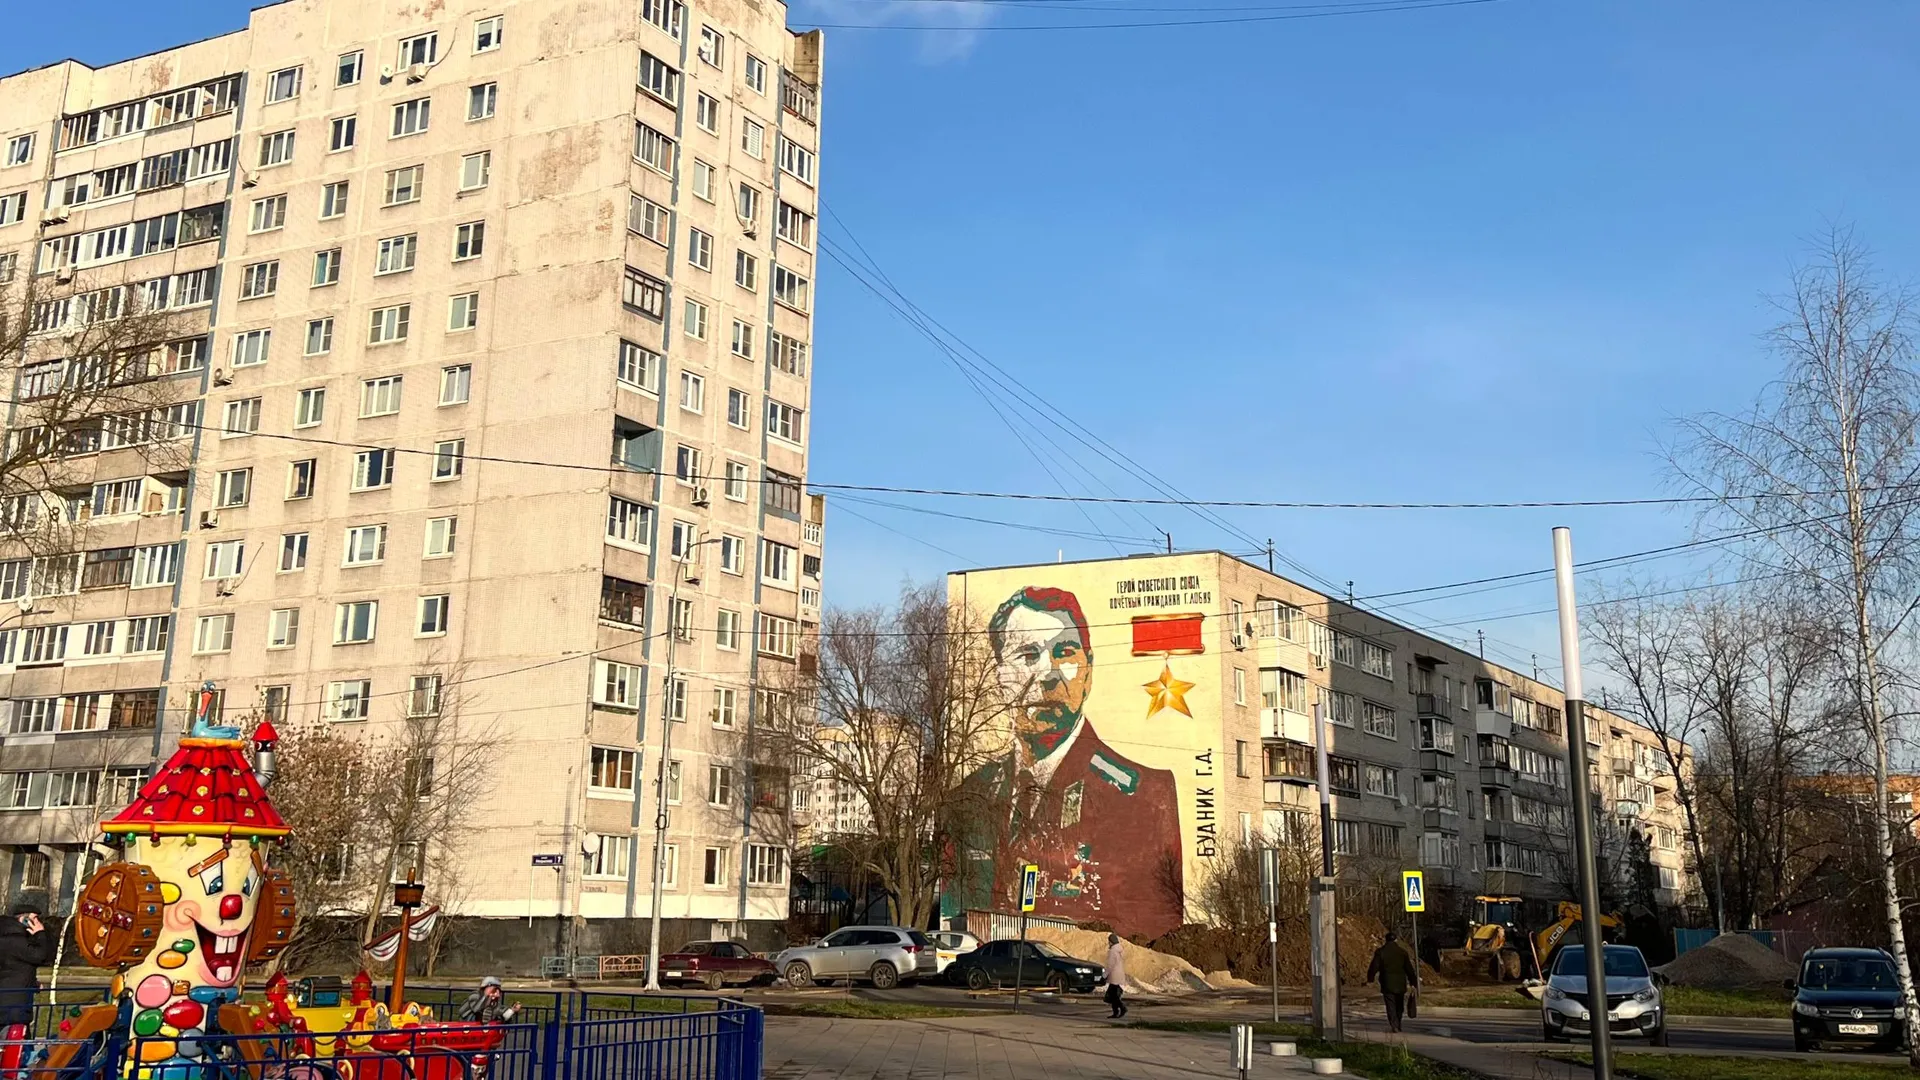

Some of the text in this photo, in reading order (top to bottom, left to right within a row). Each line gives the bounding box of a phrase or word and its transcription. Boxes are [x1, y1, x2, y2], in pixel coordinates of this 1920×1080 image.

[1116, 575, 1200, 594] ГЕРОЙ СОВЕТСКОГО СОЮЗА
[1195, 748, 1216, 857] БУДНИК Г.Д.
[1548, 925, 1564, 945] JCB
